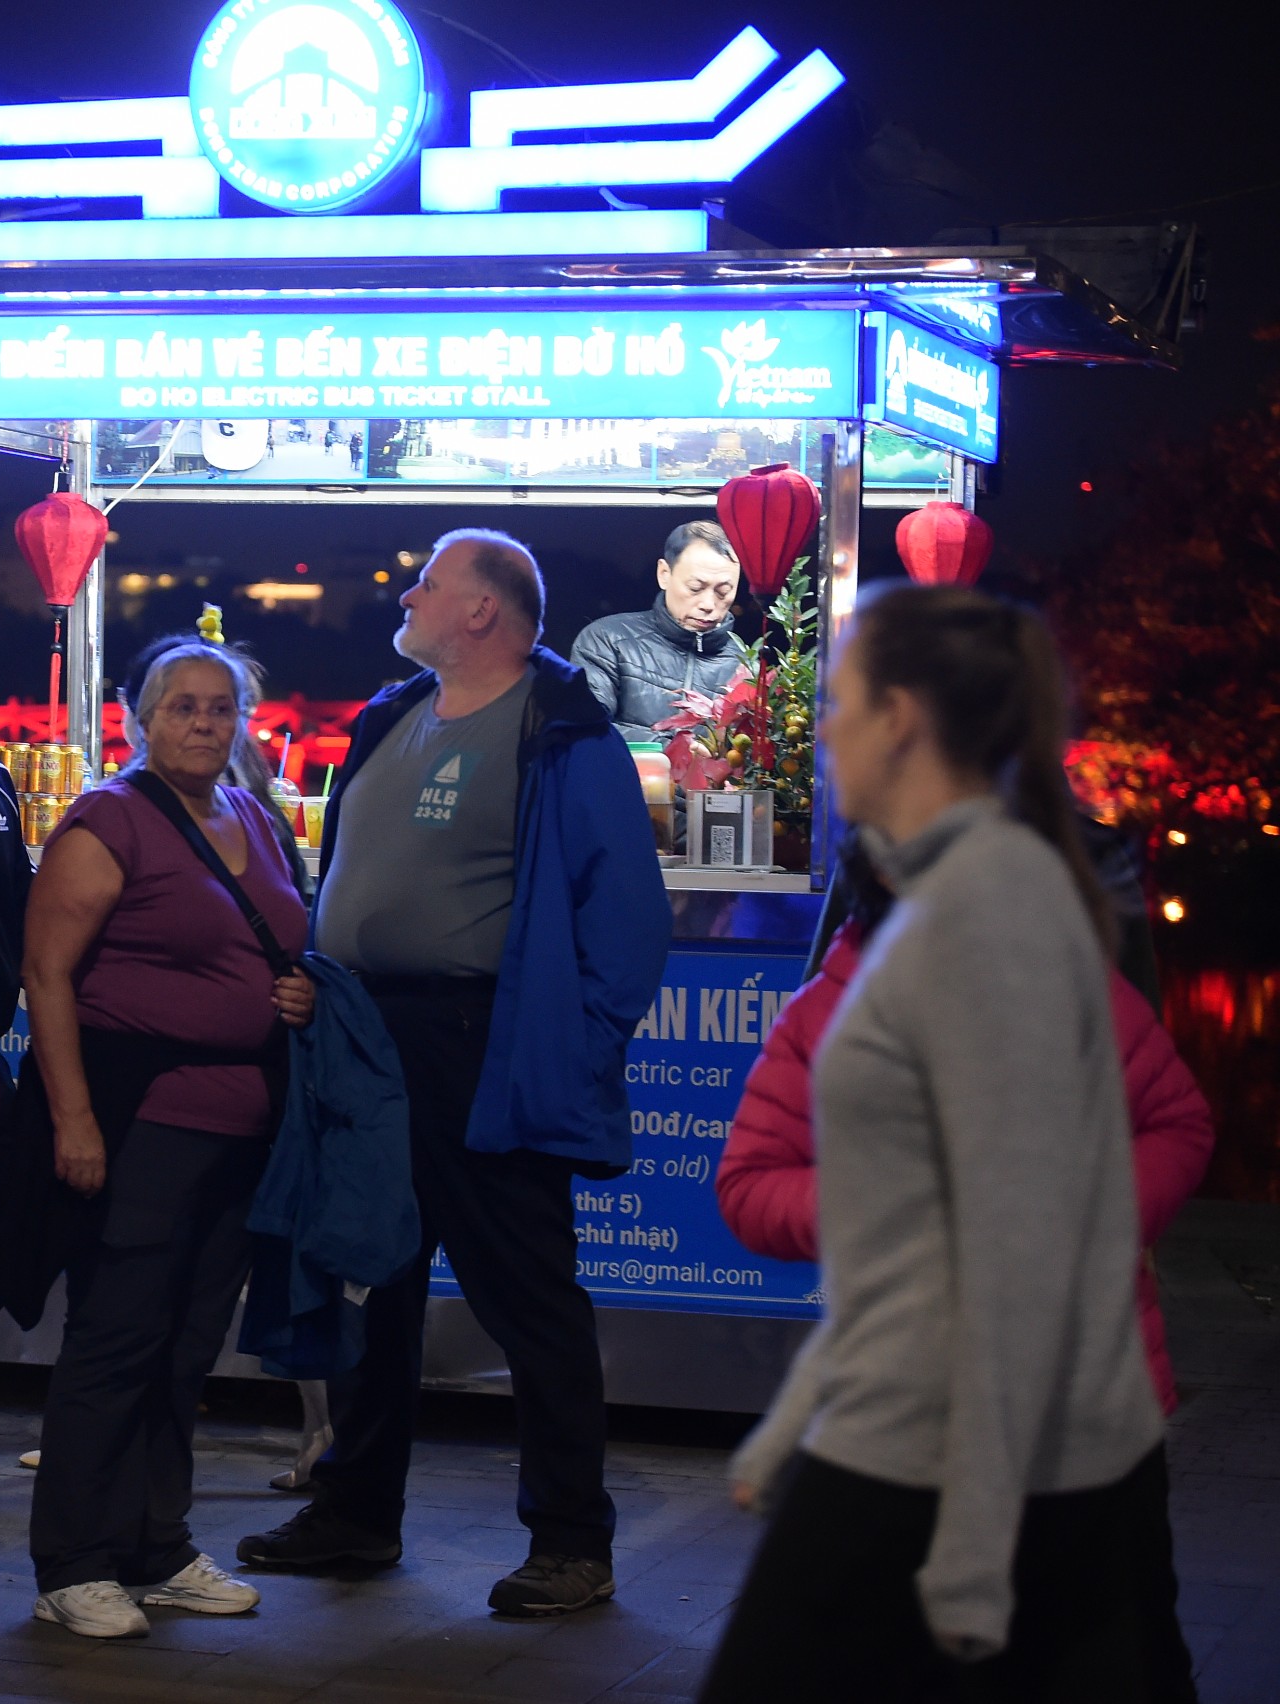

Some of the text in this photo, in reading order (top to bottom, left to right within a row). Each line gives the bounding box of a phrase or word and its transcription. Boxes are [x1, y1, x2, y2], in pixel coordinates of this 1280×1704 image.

[285, 105, 409, 201] CORPORATION
[116, 330, 202, 378] BÁN
[212, 330, 264, 377] VÉ
[372, 336, 428, 377] XE
[553, 326, 615, 376] BỜ
[120, 385, 551, 407] BO HO ELECTRIC BUS TICKET STALL
[218, 422, 235, 437] C
[419, 787, 458, 806] HLB
[625, 1059, 732, 1087] ctric car
[626, 1154, 710, 1184] rs old)
[575, 1191, 642, 1219] thứ 5)
[574, 1222, 679, 1253] chủ nhật)
